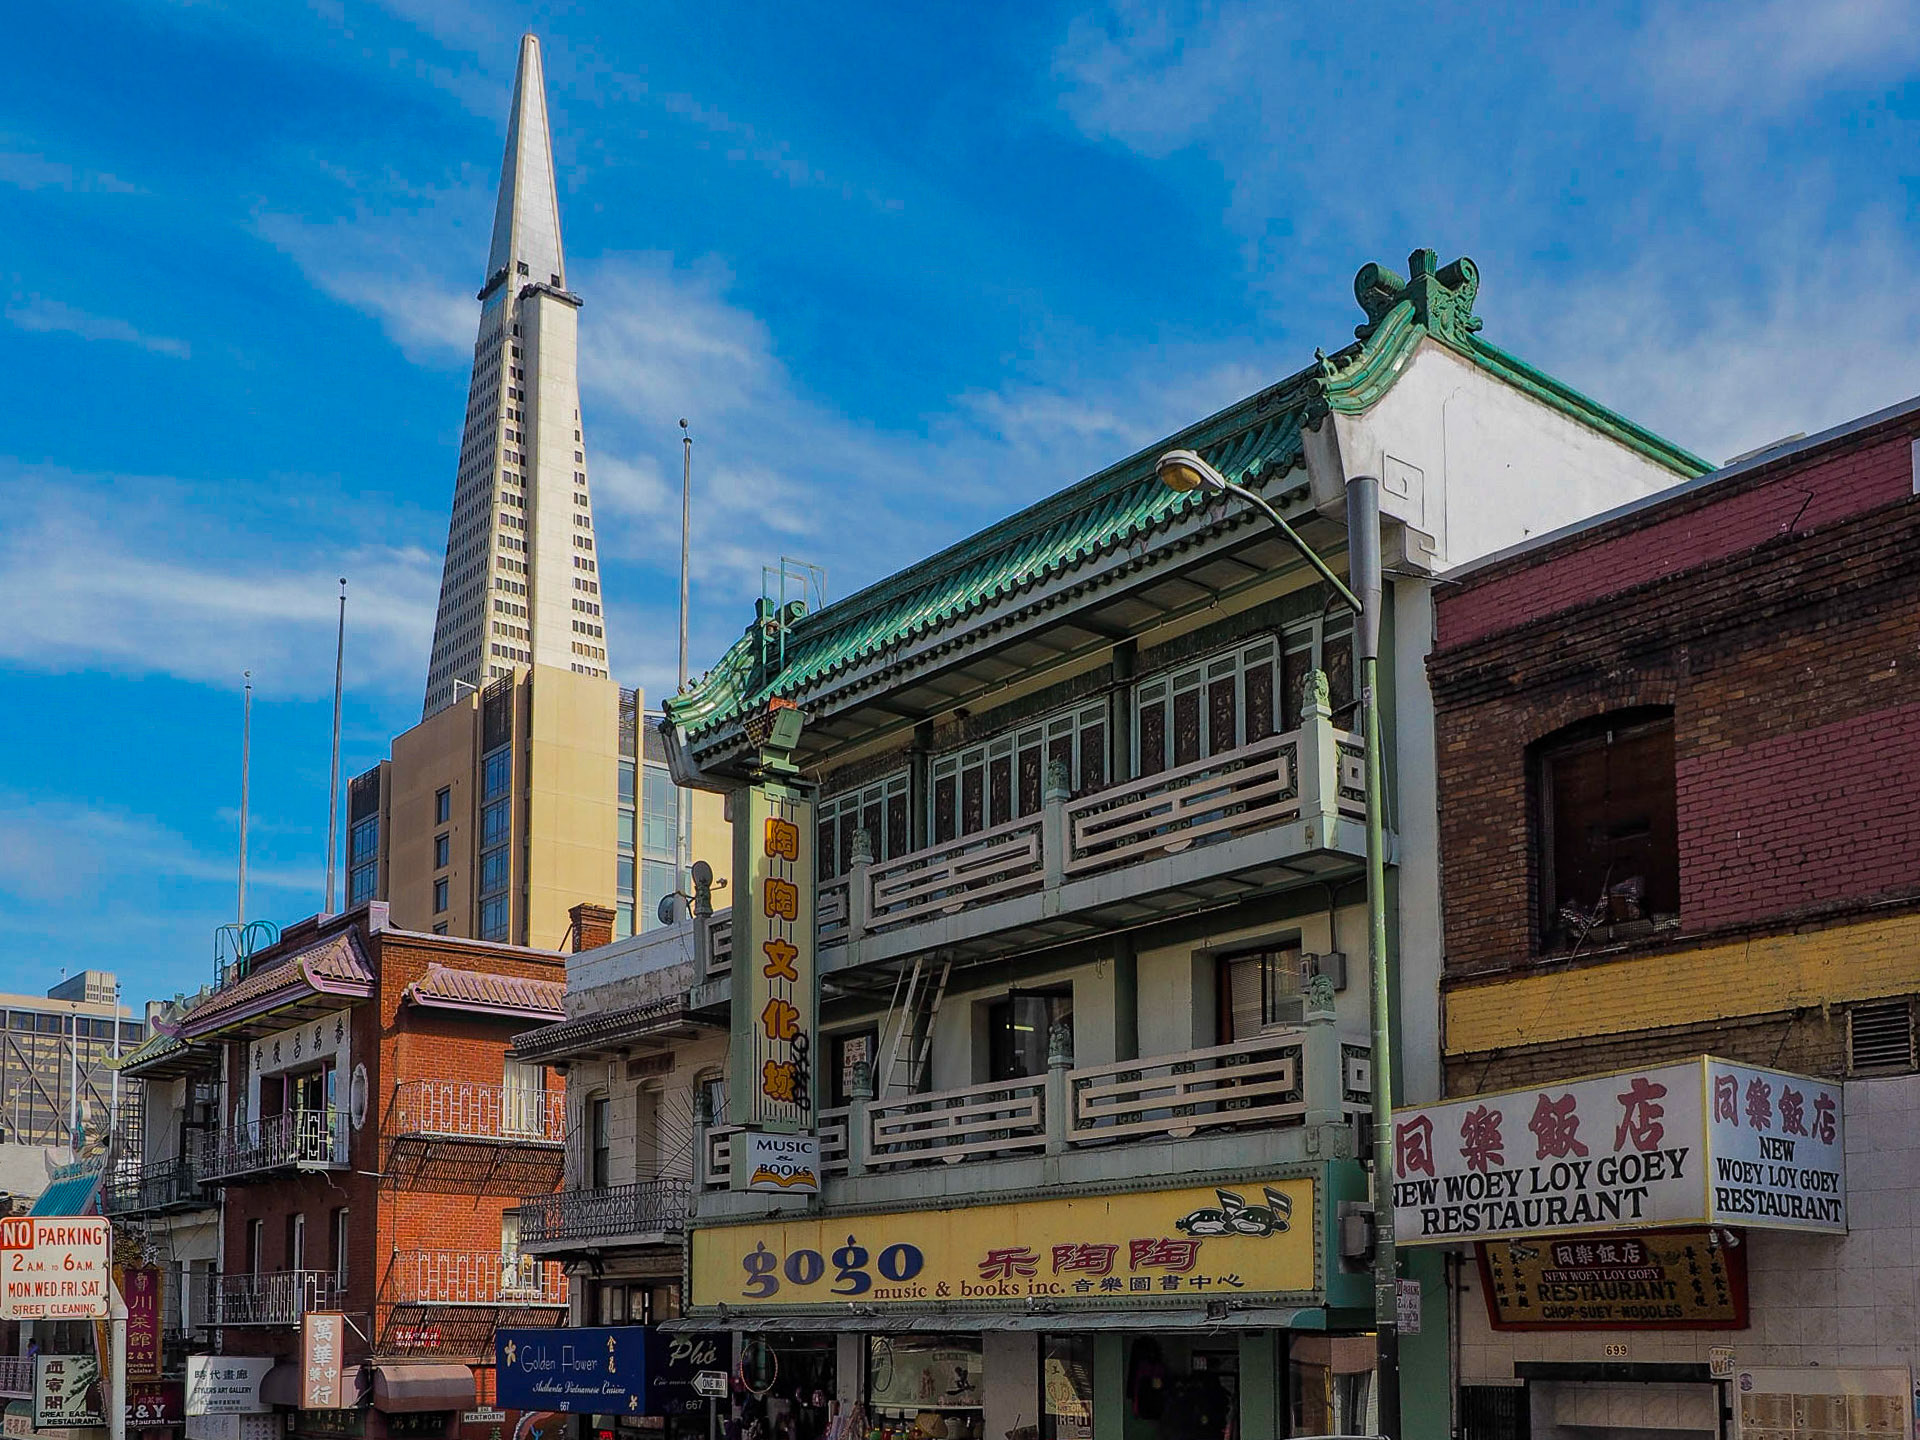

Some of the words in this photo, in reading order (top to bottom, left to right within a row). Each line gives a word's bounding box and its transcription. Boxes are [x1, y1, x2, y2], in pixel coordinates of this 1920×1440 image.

[1714, 1075, 1835, 1144] 同樂飯店
[1396, 1077, 1667, 1179] 同樂飯店
[757, 1140, 812, 1153] MUSIC
[1759, 1137, 1795, 1161] NEW
[760, 1164, 809, 1176] BOOKS
[1393, 1179, 1440, 1208] NEW
[1444, 1168, 1523, 1202] WOEY
[1530, 1160, 1594, 1194] LOY
[1597, 1147, 1689, 1187] GOEY
[1717, 1158, 1763, 1184] WOEY
[1768, 1165, 1798, 1189] LOY
[1800, 1170, 1839, 1193] GOEY
[1420, 1187, 1649, 1236] RESTAURANT
[1716, 1187, 1842, 1222] RESTAURANT
[3, 1222, 31, 1247] NO
[39, 1227, 101, 1246] PARKING
[13, 1254, 24, 1271] 2
[27, 1262, 46, 1271] A.M.
[64, 1253, 74, 1271] 6
[77, 1262, 95, 1271] A.M.
[1556, 1243, 1640, 1265] 同樂飯店
[742, 1234, 924, 1298] gogo
[1544, 1271, 1569, 1281] NEW
[1570, 1270, 1601, 1281] WOEY
[1602, 1269, 1626, 1280] LOY
[1627, 1268, 1660, 1280] GOEY
[874, 1283, 927, 1298] music
[936, 1281, 951, 1298] &
[961, 1279, 1019, 1297] books
[1028, 1279, 1065, 1295] inc.
[1537, 1281, 1676, 1301] RESTAURANT
[12, 1304, 45, 1315] STREET
[51, 1303, 95, 1314] CLEANING
[521, 1345, 556, 1373] Golden
[562, 1346, 598, 1373] Flower
[1606, 1345, 1627, 1356] 699
[564, 1381, 599, 1394] Vietnamese
[602, 1380, 626, 1395] Cuisine
[703, 1379, 713, 1388] ONE
[560, 1401, 570, 1411] 667
[685, 1400, 704, 1410] 667
